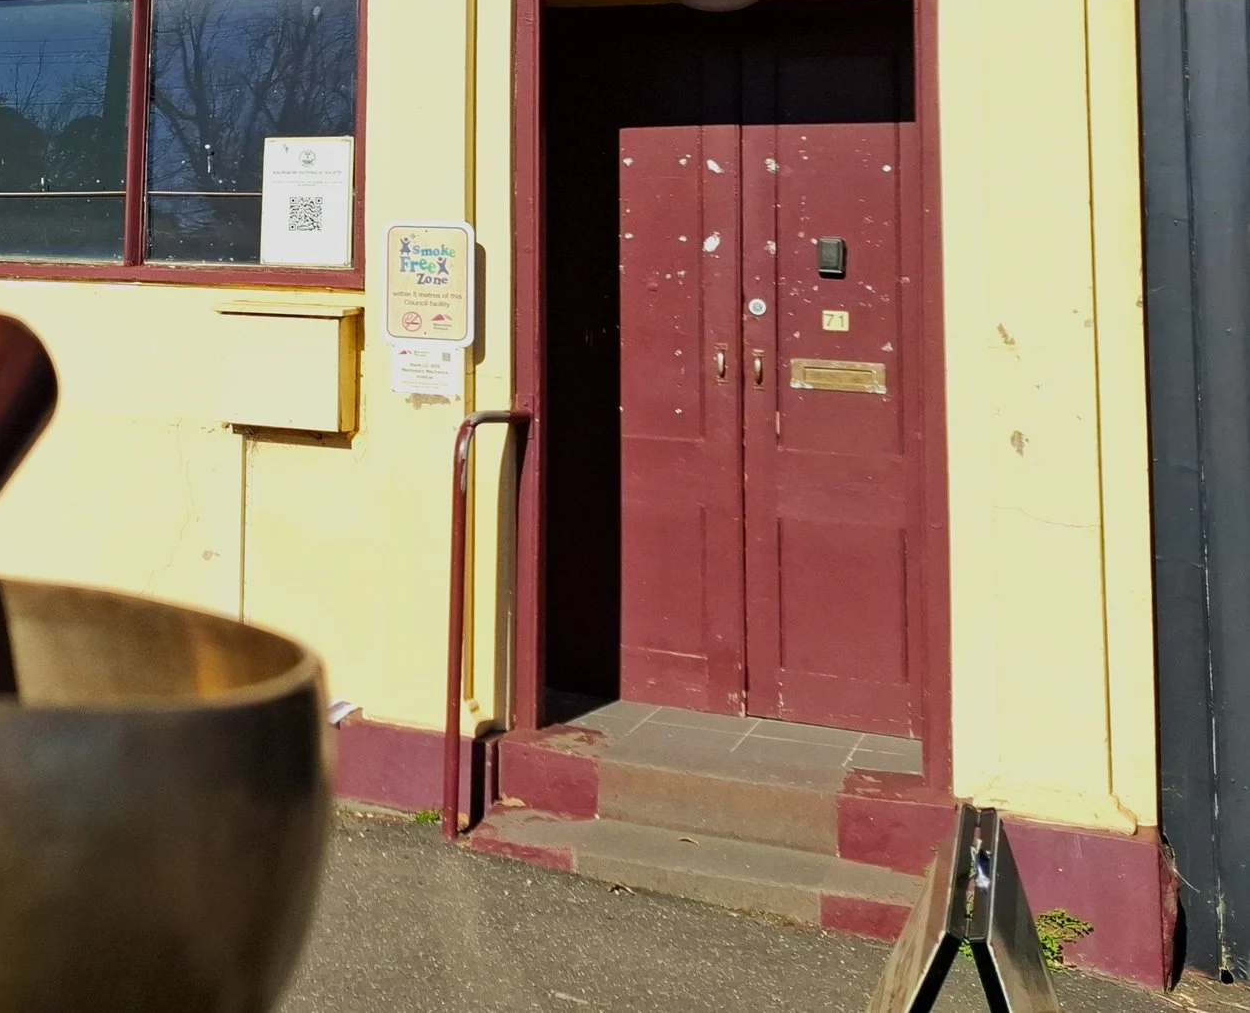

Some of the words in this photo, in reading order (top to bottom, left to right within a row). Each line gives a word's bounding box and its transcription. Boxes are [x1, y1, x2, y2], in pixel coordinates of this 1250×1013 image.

[412, 244, 456, 258] Smoke
[400, 256, 436, 274] Free
[416, 273, 448, 285] Zone
[429, 300, 450, 308] facility
[824, 313, 845, 328] 71
